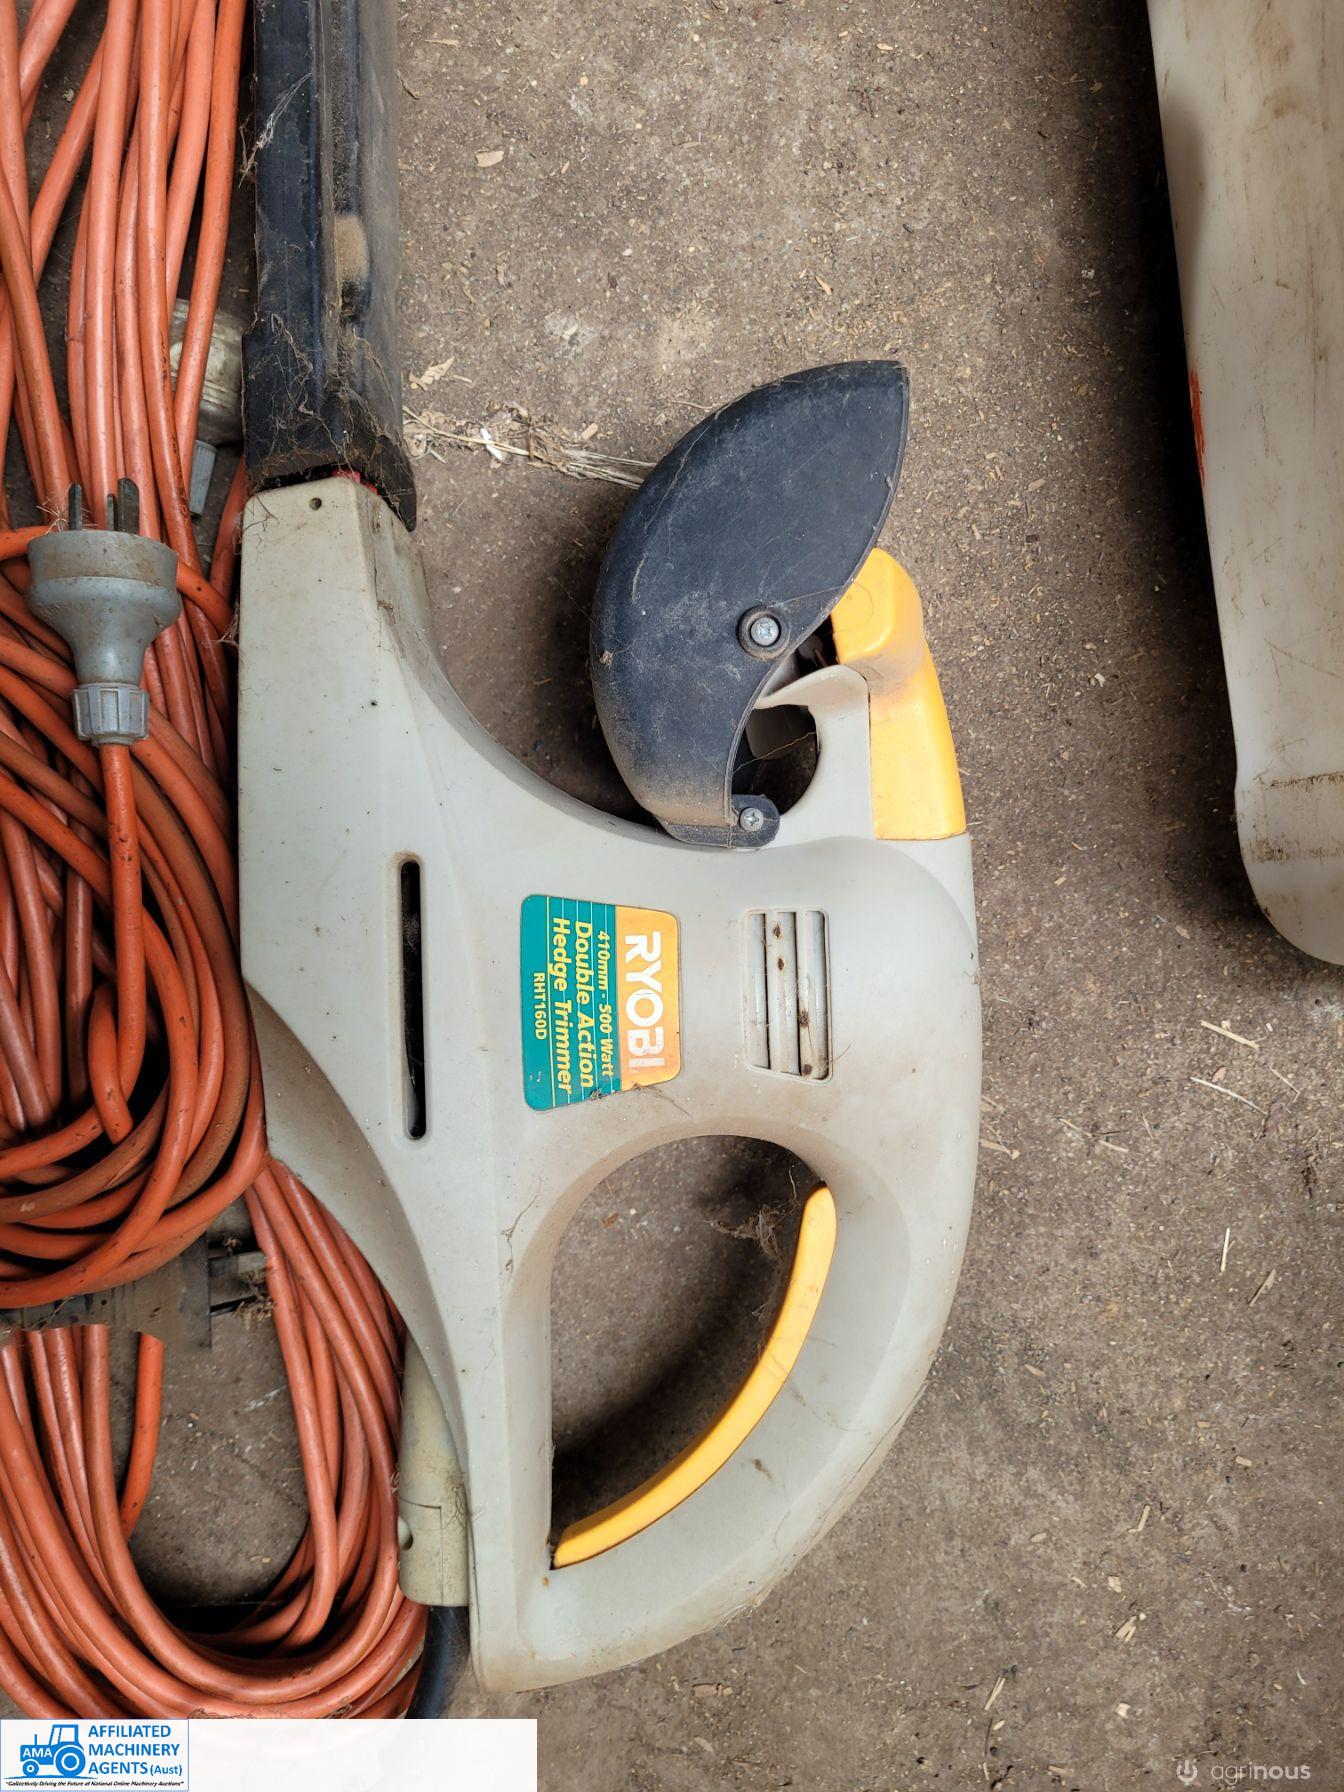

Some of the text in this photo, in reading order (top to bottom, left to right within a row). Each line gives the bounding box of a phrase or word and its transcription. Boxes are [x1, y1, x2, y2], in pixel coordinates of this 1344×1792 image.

[597, 931, 611, 990] 410mm
[533, 972, 547, 1040] RHT160D
[549, 917, 573, 1095] Hedge Trimmer
[575, 921, 596, 1087] Double Action
[599, 1004, 612, 1034] 500
[625, 931, 665, 1068] RYOBI
[600, 1038, 614, 1077] Watt
